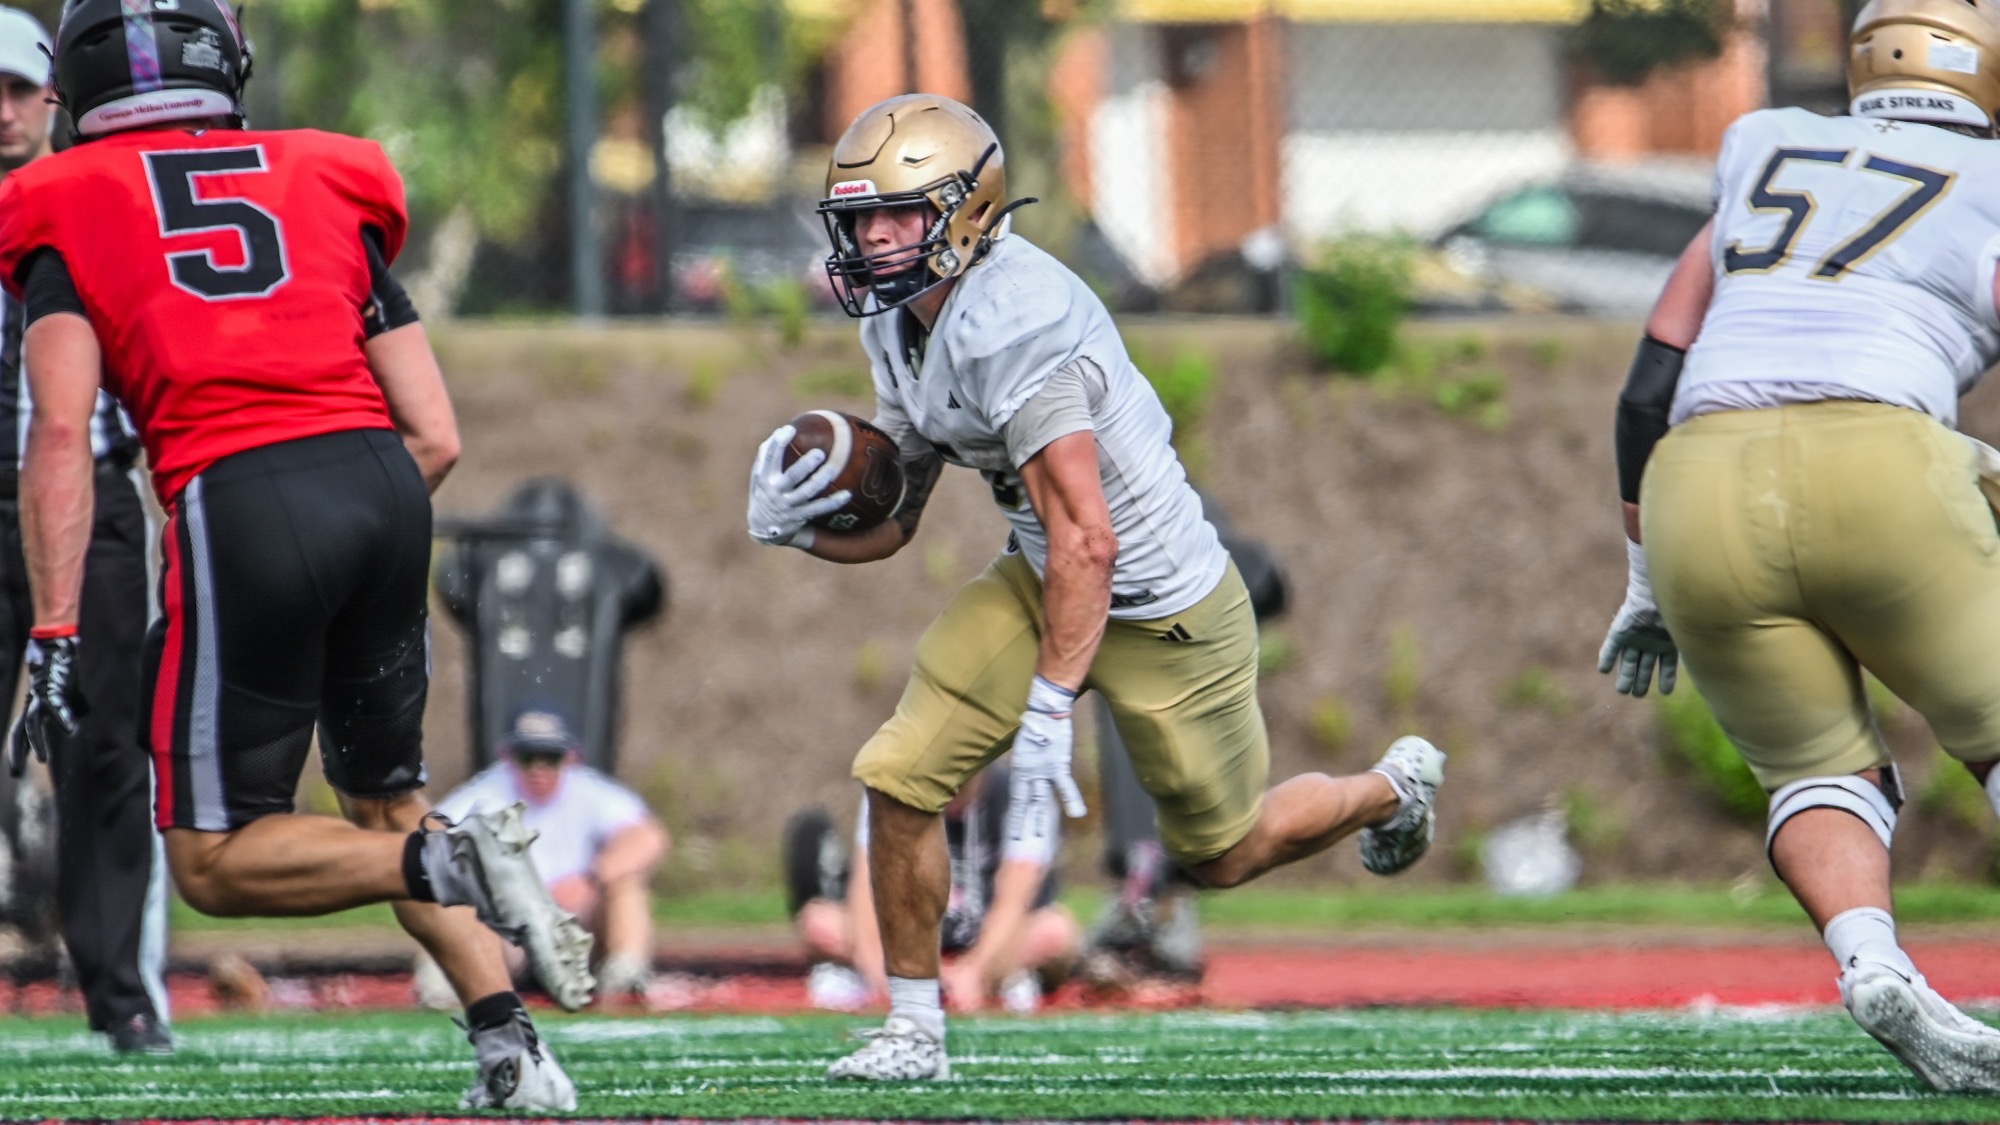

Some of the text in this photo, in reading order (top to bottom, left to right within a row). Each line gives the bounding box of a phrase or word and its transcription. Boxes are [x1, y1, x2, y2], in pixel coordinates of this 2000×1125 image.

[99, 98, 204, 121] Carnegie Mellon University
[1859, 96, 1954, 113] BLUE STREAKS
[834, 183, 867, 195] Riddell
[138, 144, 293, 303] 5
[1724, 146, 1959, 282] 57
